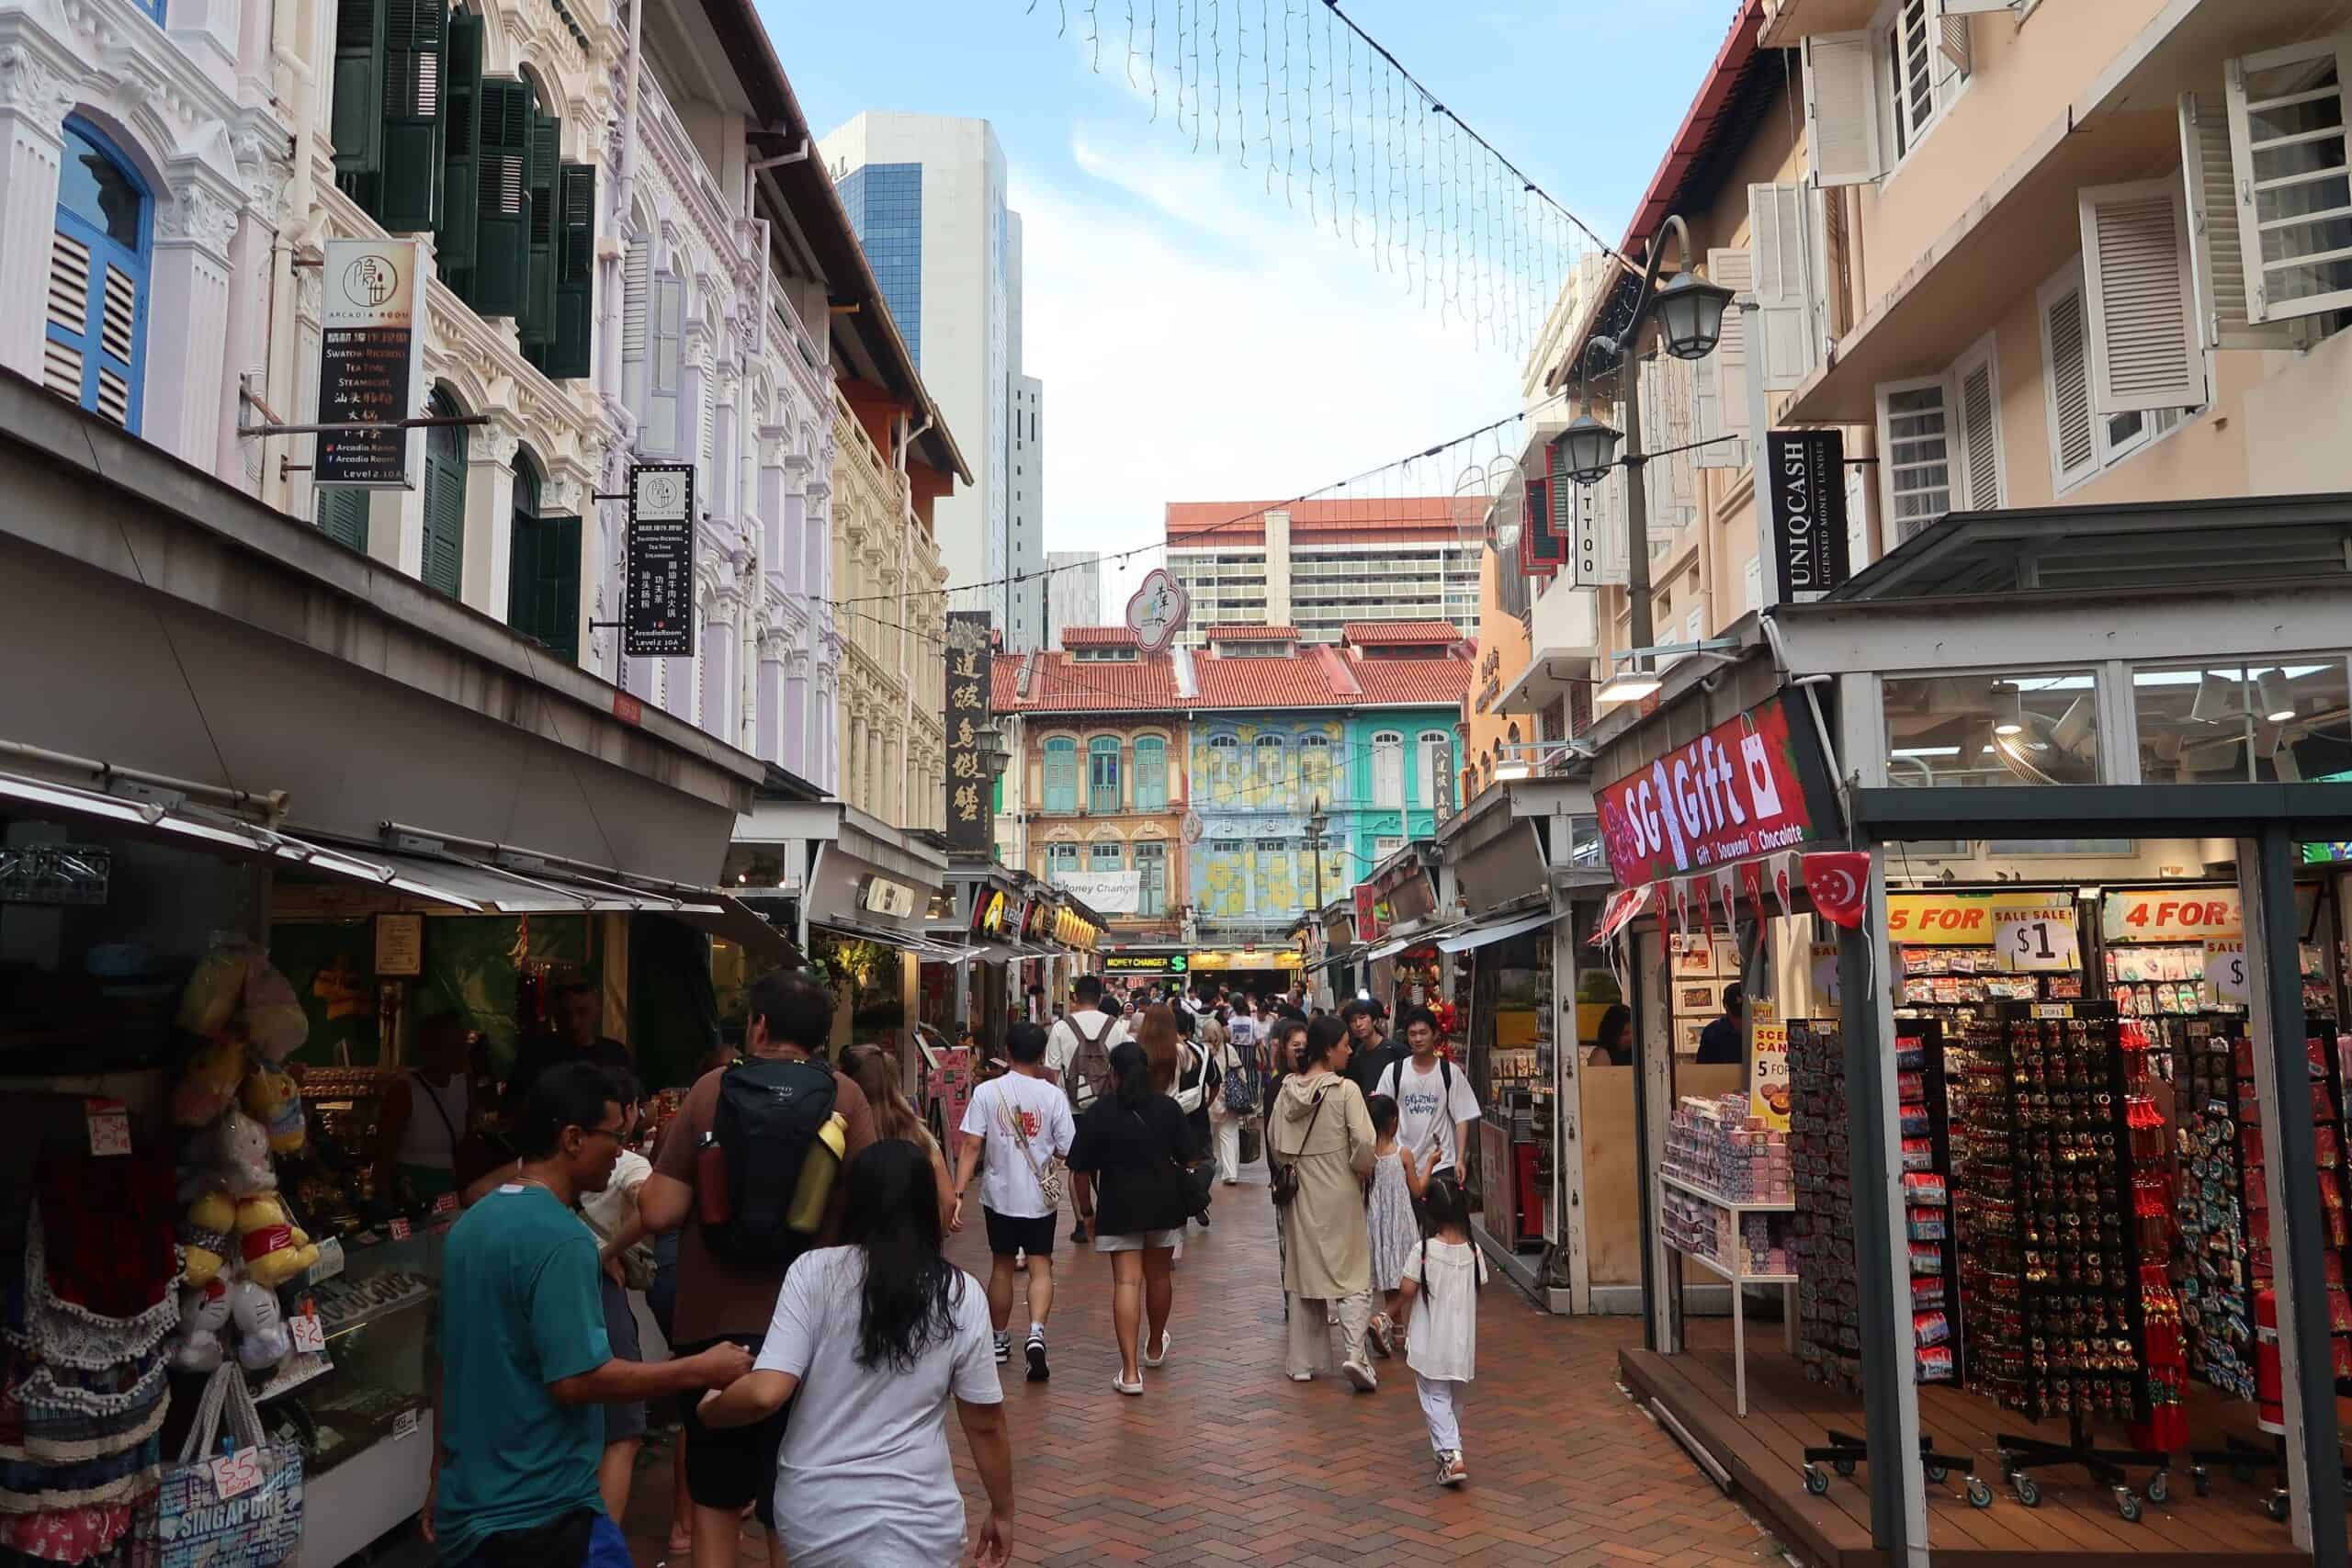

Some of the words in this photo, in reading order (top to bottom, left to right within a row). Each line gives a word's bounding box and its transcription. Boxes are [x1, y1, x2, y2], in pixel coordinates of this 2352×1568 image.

[336, 445, 368, 453] Arcadia
[336, 456, 368, 464] Arcadia
[1815, 440, 1825, 483] LENDER
[344, 469, 371, 479] Level
[1784, 441, 1811, 586] UNIQCASH
[1818, 488, 1827, 526] MONEY
[1821, 530, 1831, 586] LICENSED
[1696, 844, 1712, 866] Gift
[1758, 823, 1804, 851] Chocolate
[1888, 909, 1908, 931] 5
[1917, 908, 1984, 930] FOR
[1995, 911, 2028, 921] SALE
[2125, 903, 2150, 928] 4
[2155, 901, 2229, 927] FOR
[1106, 957, 1132, 967] MONEY
[1133, 957, 1168, 968] CHANGER
[1758, 1060, 1768, 1077] 5
[295, 1322, 322, 1345] $2
[220, 1451, 255, 1487] $5
[181, 1493, 287, 1538] SINGAPORE
